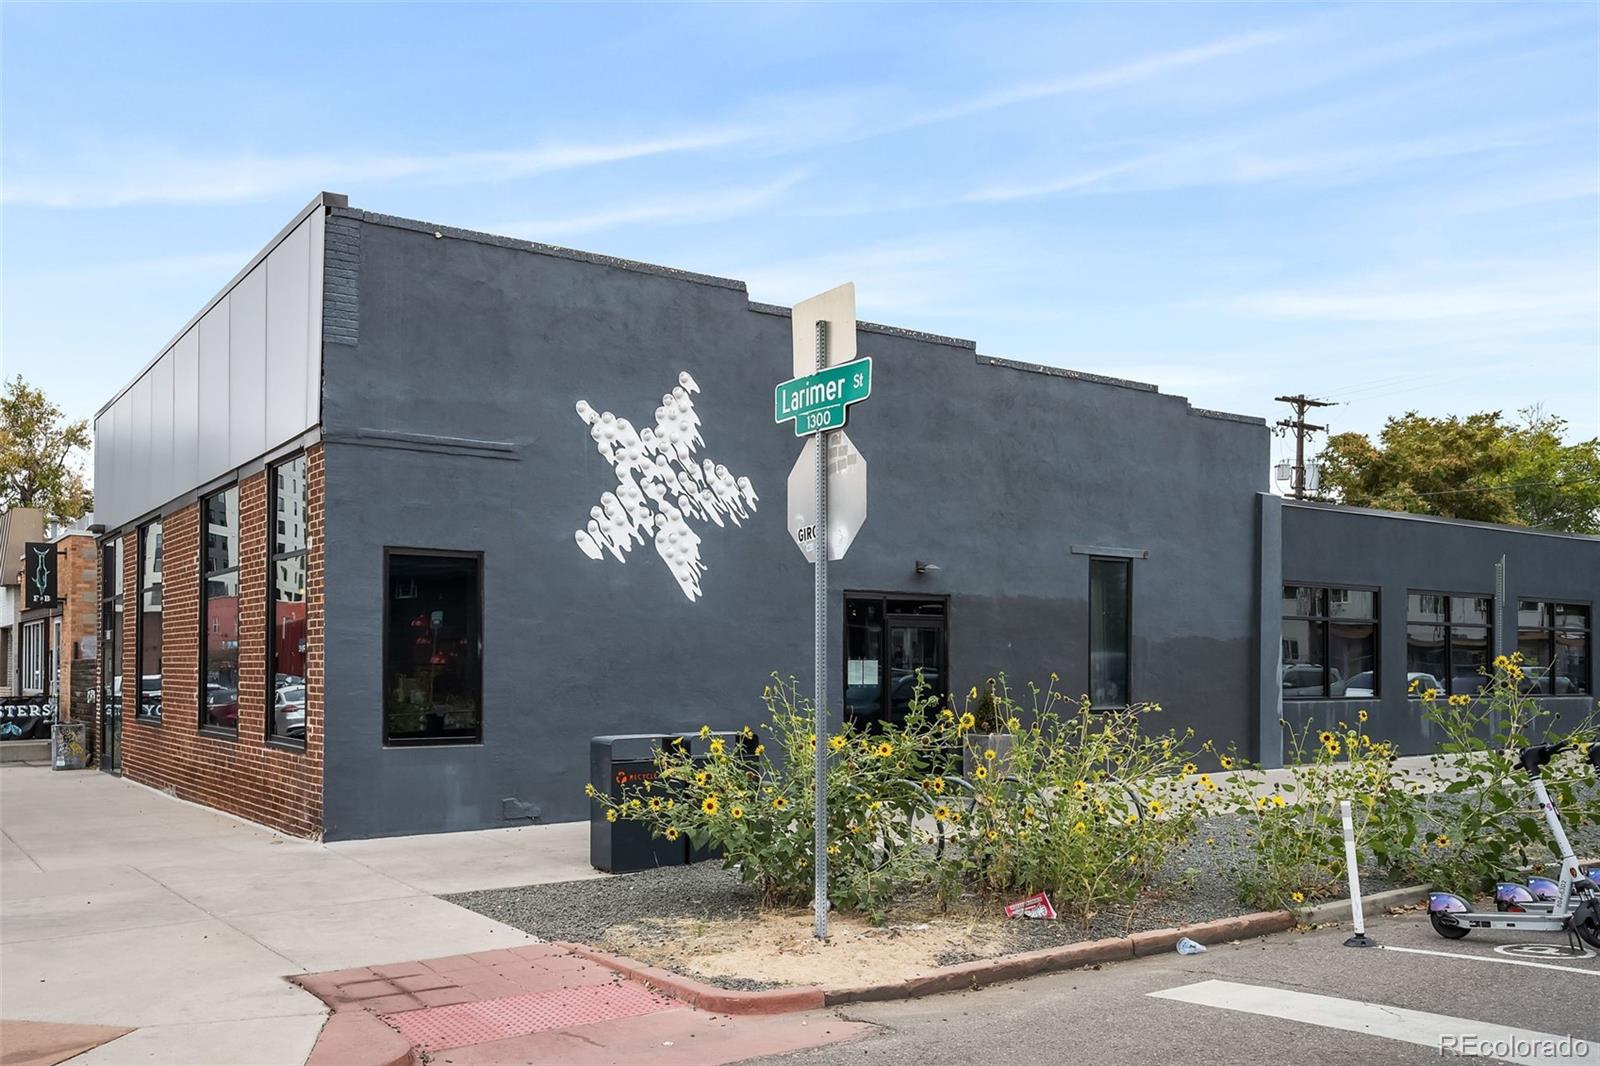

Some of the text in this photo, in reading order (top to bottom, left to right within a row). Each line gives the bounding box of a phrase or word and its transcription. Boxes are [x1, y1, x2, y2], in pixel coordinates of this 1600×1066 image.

[782, 372, 864, 413] Larimer St
[807, 410, 831, 429] 1300
